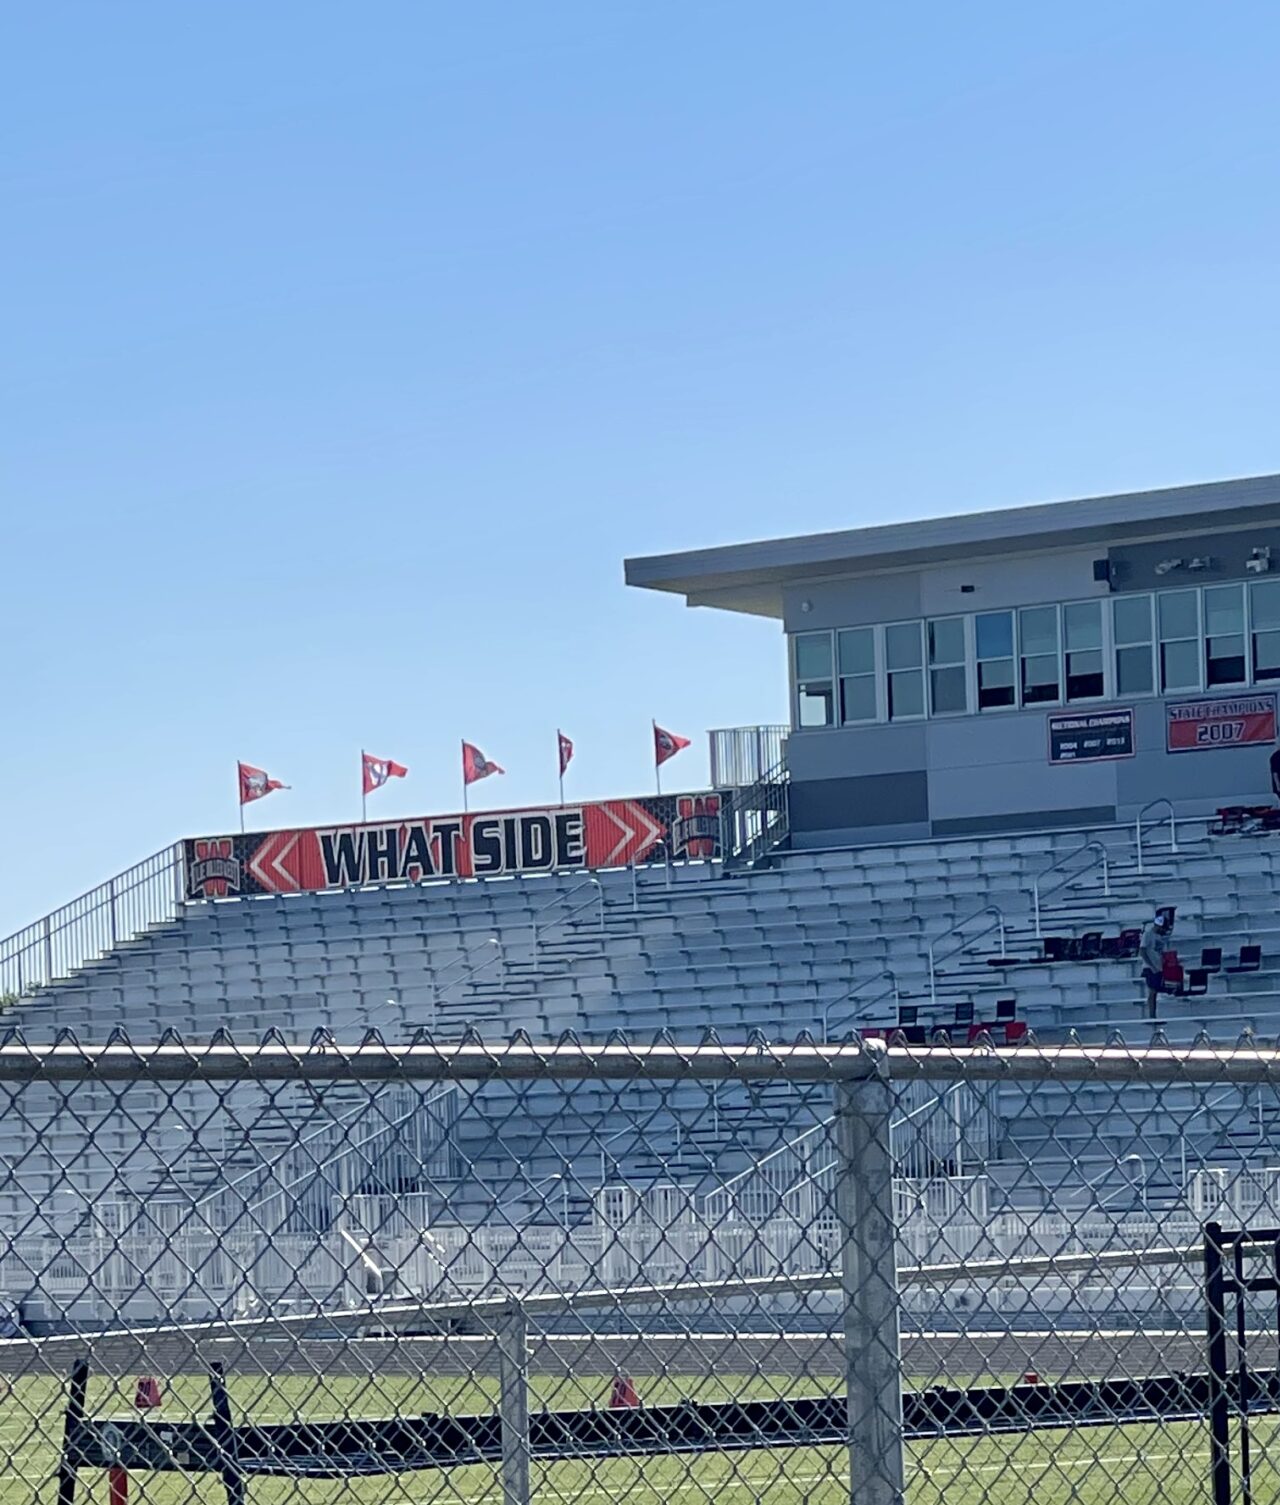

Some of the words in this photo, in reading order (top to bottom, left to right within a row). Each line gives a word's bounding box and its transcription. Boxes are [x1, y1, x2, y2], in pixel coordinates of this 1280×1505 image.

[1169, 707, 1204, 720] STATE
[1206, 700, 1273, 718] CHAMPIONS
[1089, 715, 1130, 728] CHAMPIONS
[1198, 722, 1246, 744] 2007
[315, 816, 465, 889] WHAT
[472, 808, 587, 877] SIDE
